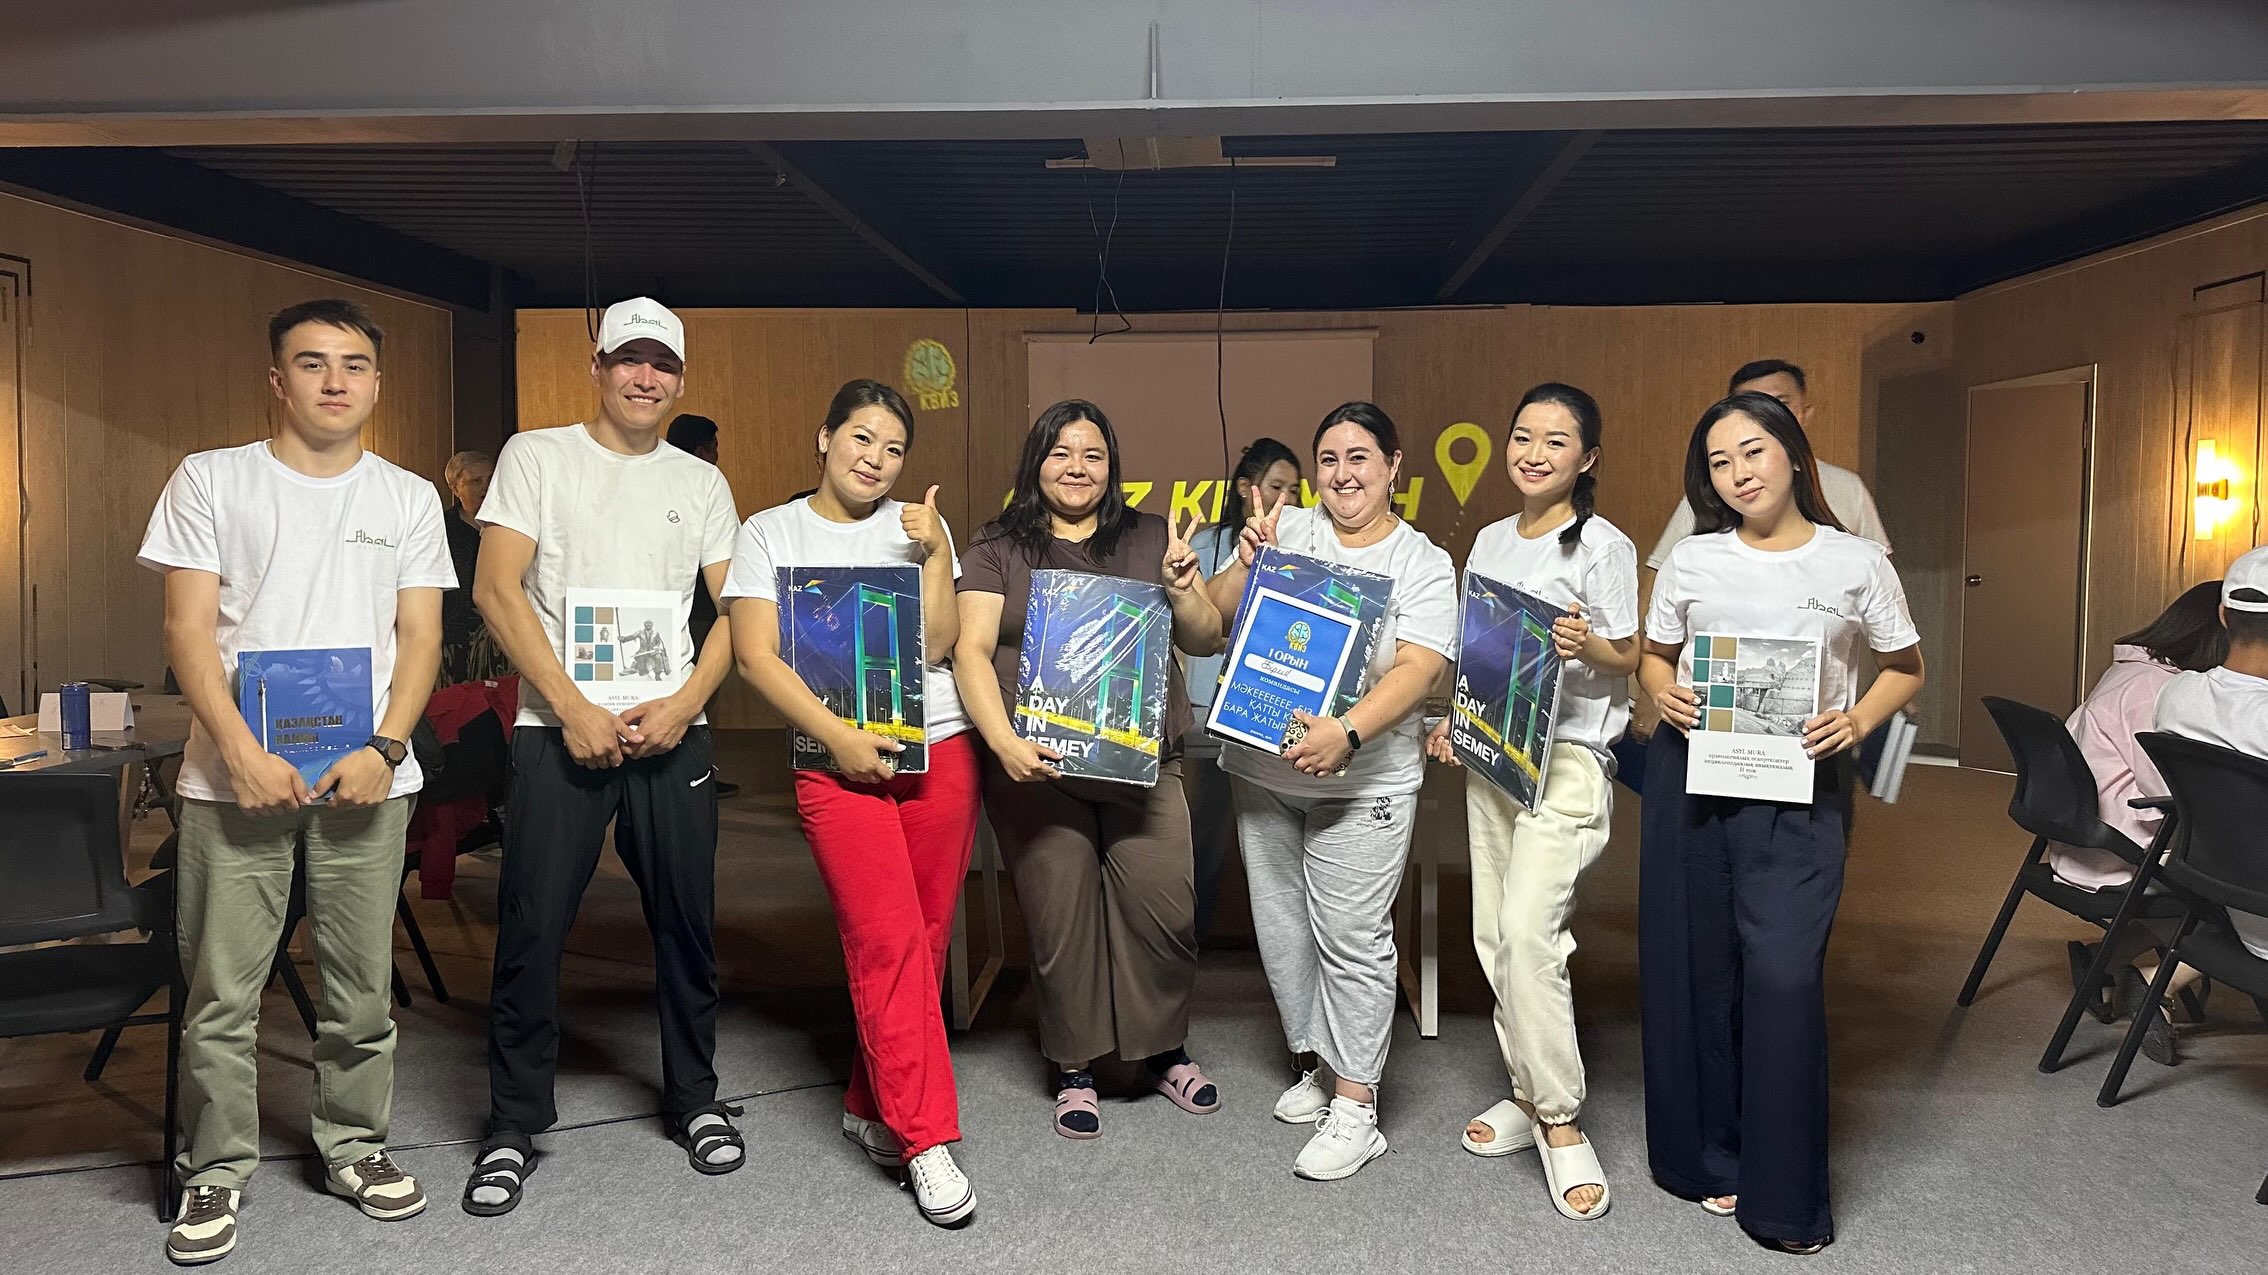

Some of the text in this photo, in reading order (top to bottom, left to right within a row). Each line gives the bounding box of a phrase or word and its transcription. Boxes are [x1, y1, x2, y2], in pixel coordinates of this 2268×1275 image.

[1261, 564, 1277, 574] KAZ
[1274, 650, 1309, 671] ОРЫН
[1458, 675, 1469, 692] A
[1028, 695, 1069, 714] DAY
[1457, 692, 1486, 717] DAY
[1026, 715, 1047, 733] IN
[1223, 702, 1249, 719] БАРА
[1251, 712, 1287, 731] ЖАТЫР
[1455, 710, 1470, 730] IN
[1453, 728, 1500, 766] SEMEY
